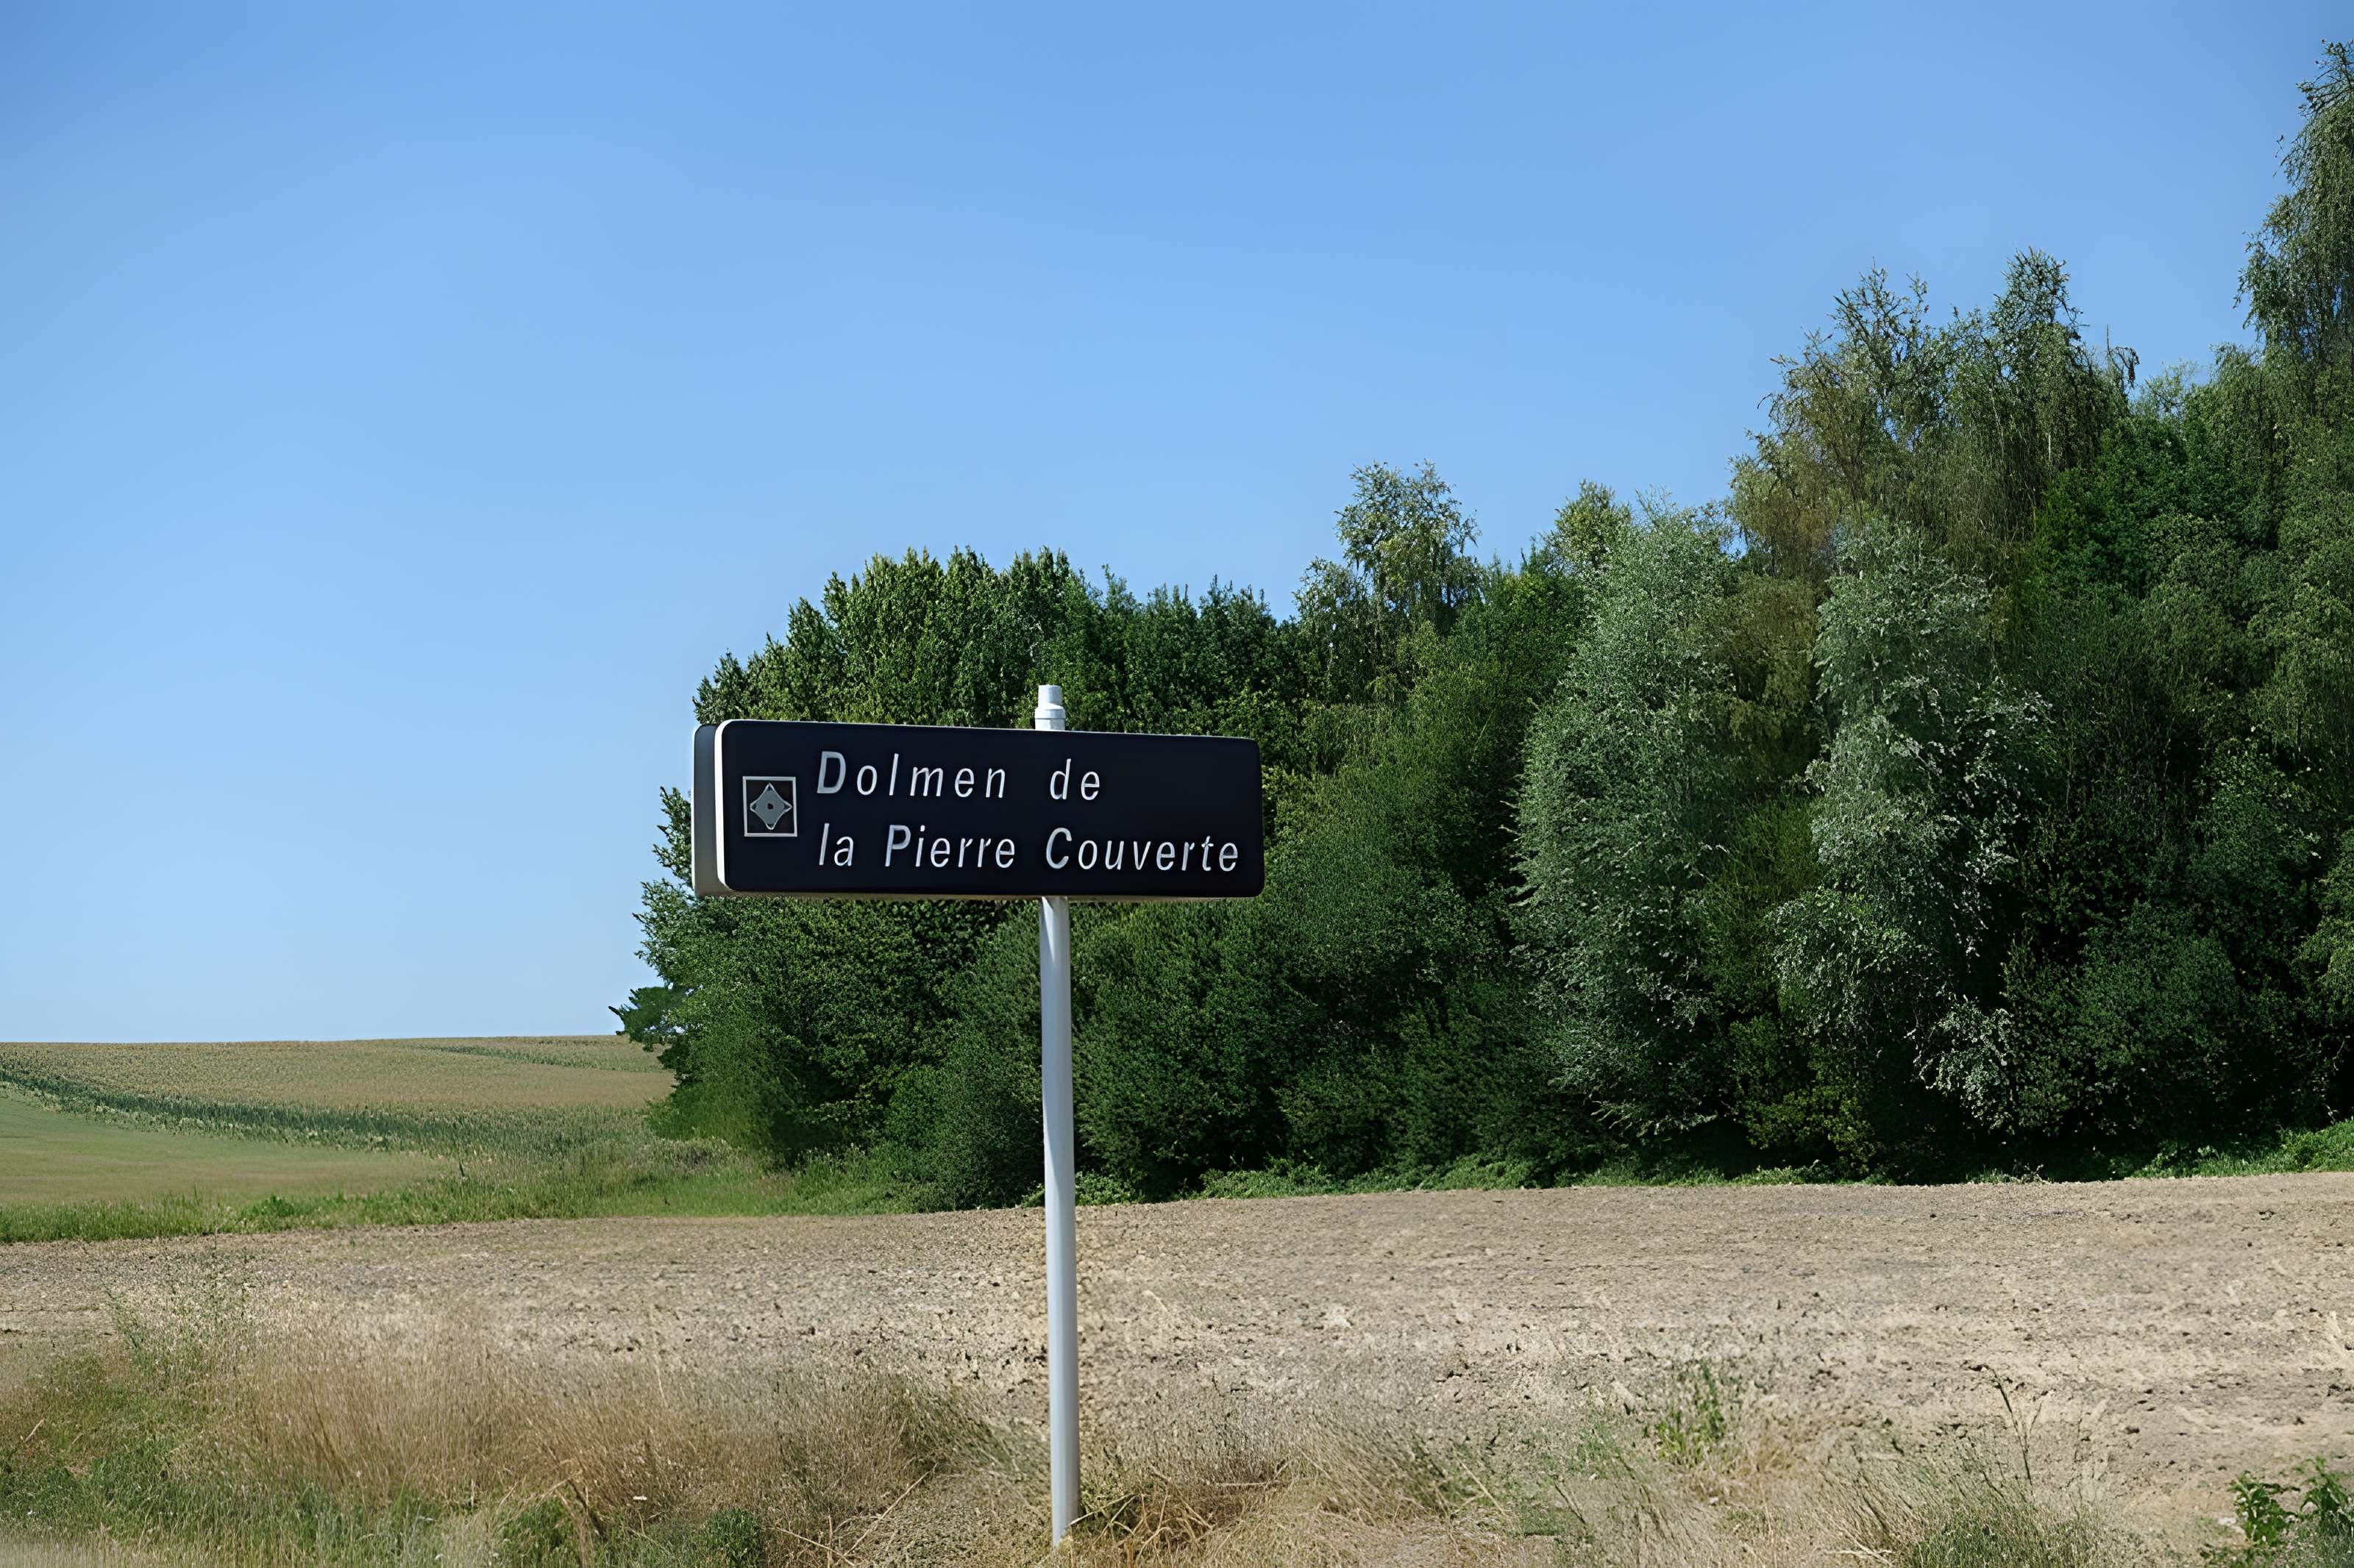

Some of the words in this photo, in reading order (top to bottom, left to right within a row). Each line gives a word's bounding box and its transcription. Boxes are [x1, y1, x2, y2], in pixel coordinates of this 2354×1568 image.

[817, 751, 1006, 799] Dolmen
[1050, 758, 1100, 801] de
[818, 822, 855, 867] la
[884, 824, 1016, 870] Pierre
[1045, 827, 1238, 872] Couverte
